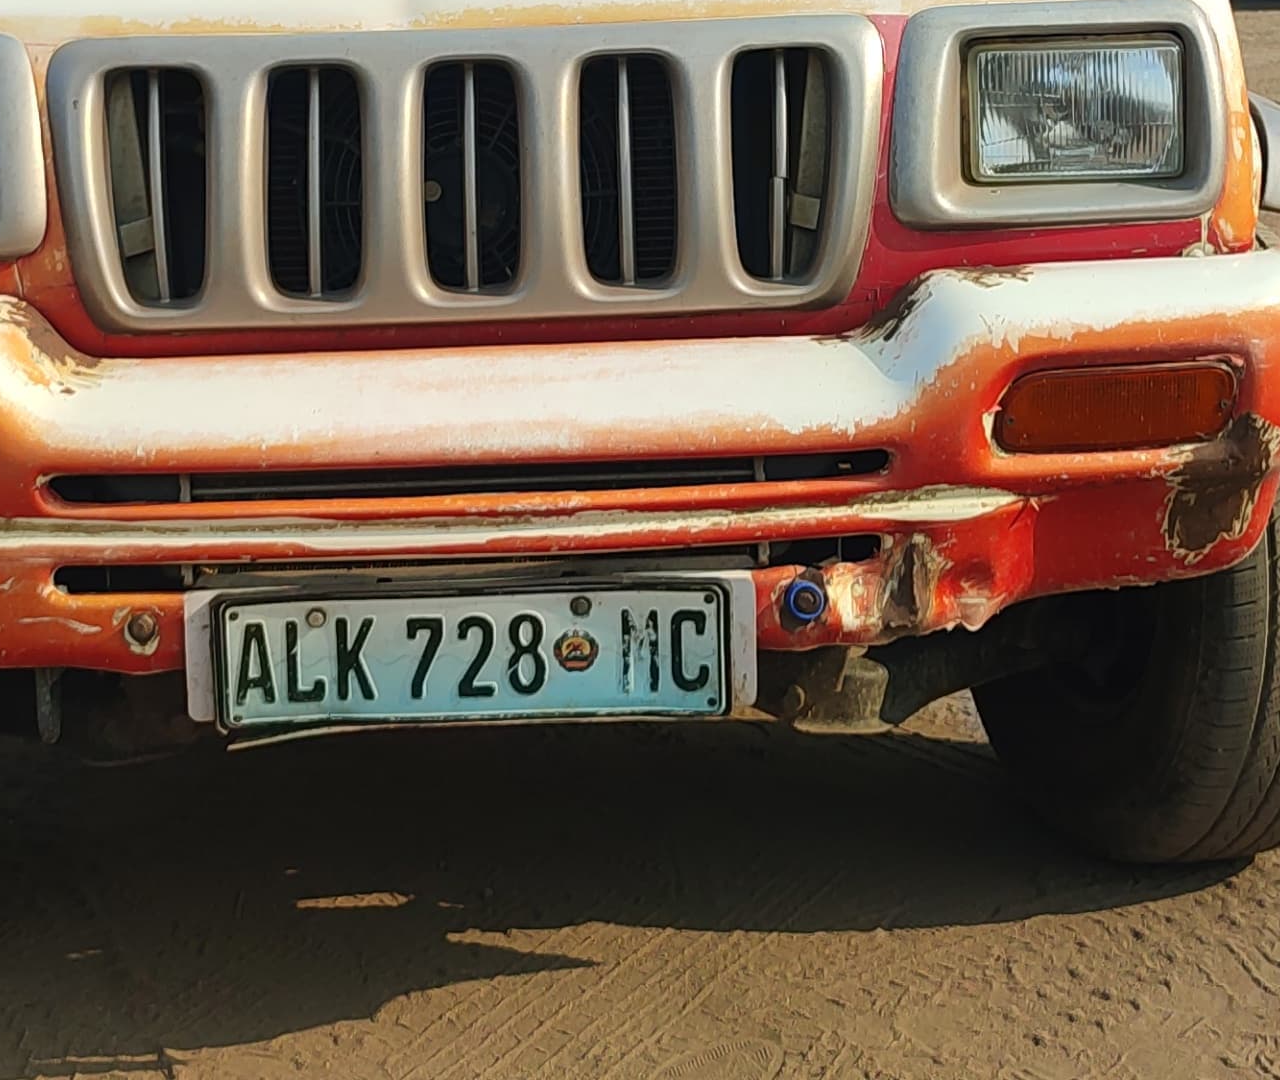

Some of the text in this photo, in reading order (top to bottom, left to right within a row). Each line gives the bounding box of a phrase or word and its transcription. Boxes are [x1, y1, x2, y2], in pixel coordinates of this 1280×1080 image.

[235, 608, 708, 705] ALK 728 MC
